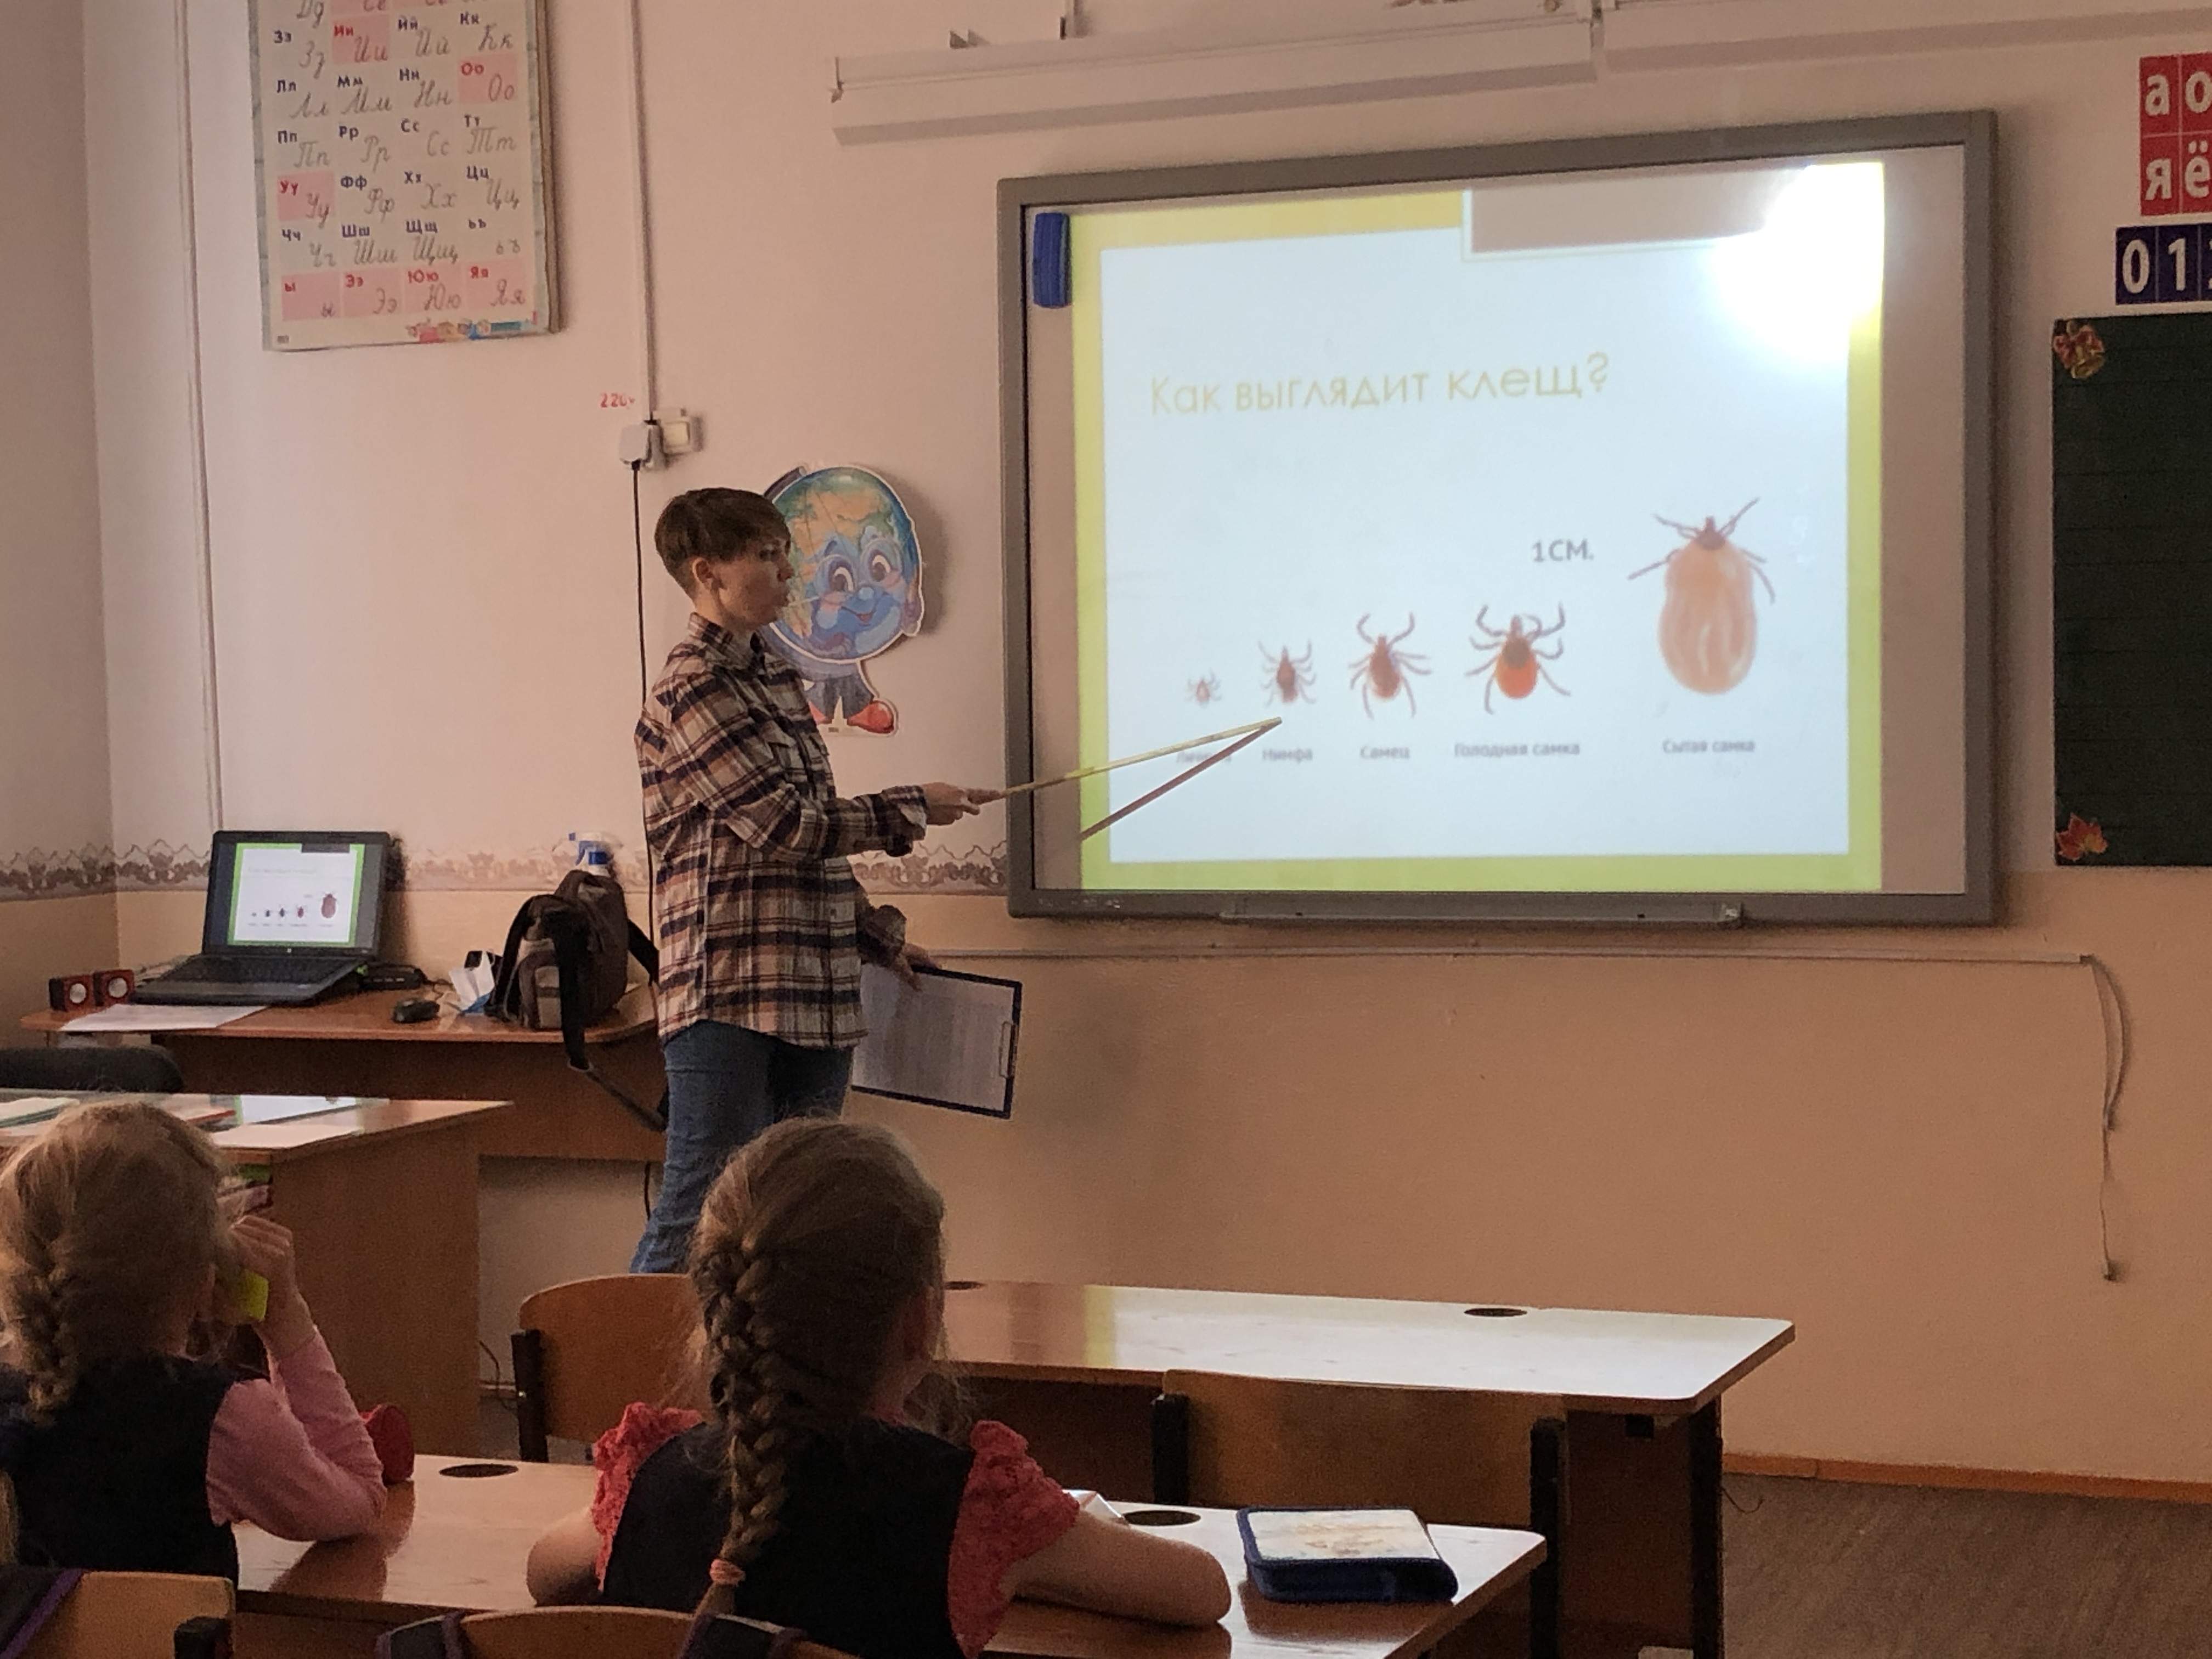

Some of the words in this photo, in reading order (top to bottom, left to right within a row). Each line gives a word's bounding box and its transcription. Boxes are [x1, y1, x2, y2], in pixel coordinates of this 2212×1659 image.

[274, 29, 292, 43] Зз
[399, 68, 420, 81] Нн
[461, 62, 484, 76] Оо
[278, 129, 298, 144] Пп
[338, 125, 359, 141] Рр
[400, 118, 420, 133] Сс
[280, 180, 298, 196] Уу
[340, 174, 368, 191] Фф
[466, 165, 489, 181] Цц
[281, 228, 301, 241] Чч
[341, 223, 371, 238] Шш
[406, 219, 438, 234] Щщ
[345, 273, 364, 289] Ээ
[408, 268, 439, 284] Юю
[471, 266, 489, 279] Яя
[1151, 375, 1221, 416] Как
[1235, 370, 1430, 411] выглядит
[1448, 351, 1609, 402] клещ?
[1454, 742, 1528, 758] Голодная
[1532, 742, 1580, 756] самка
[1712, 740, 1756, 753] самка
